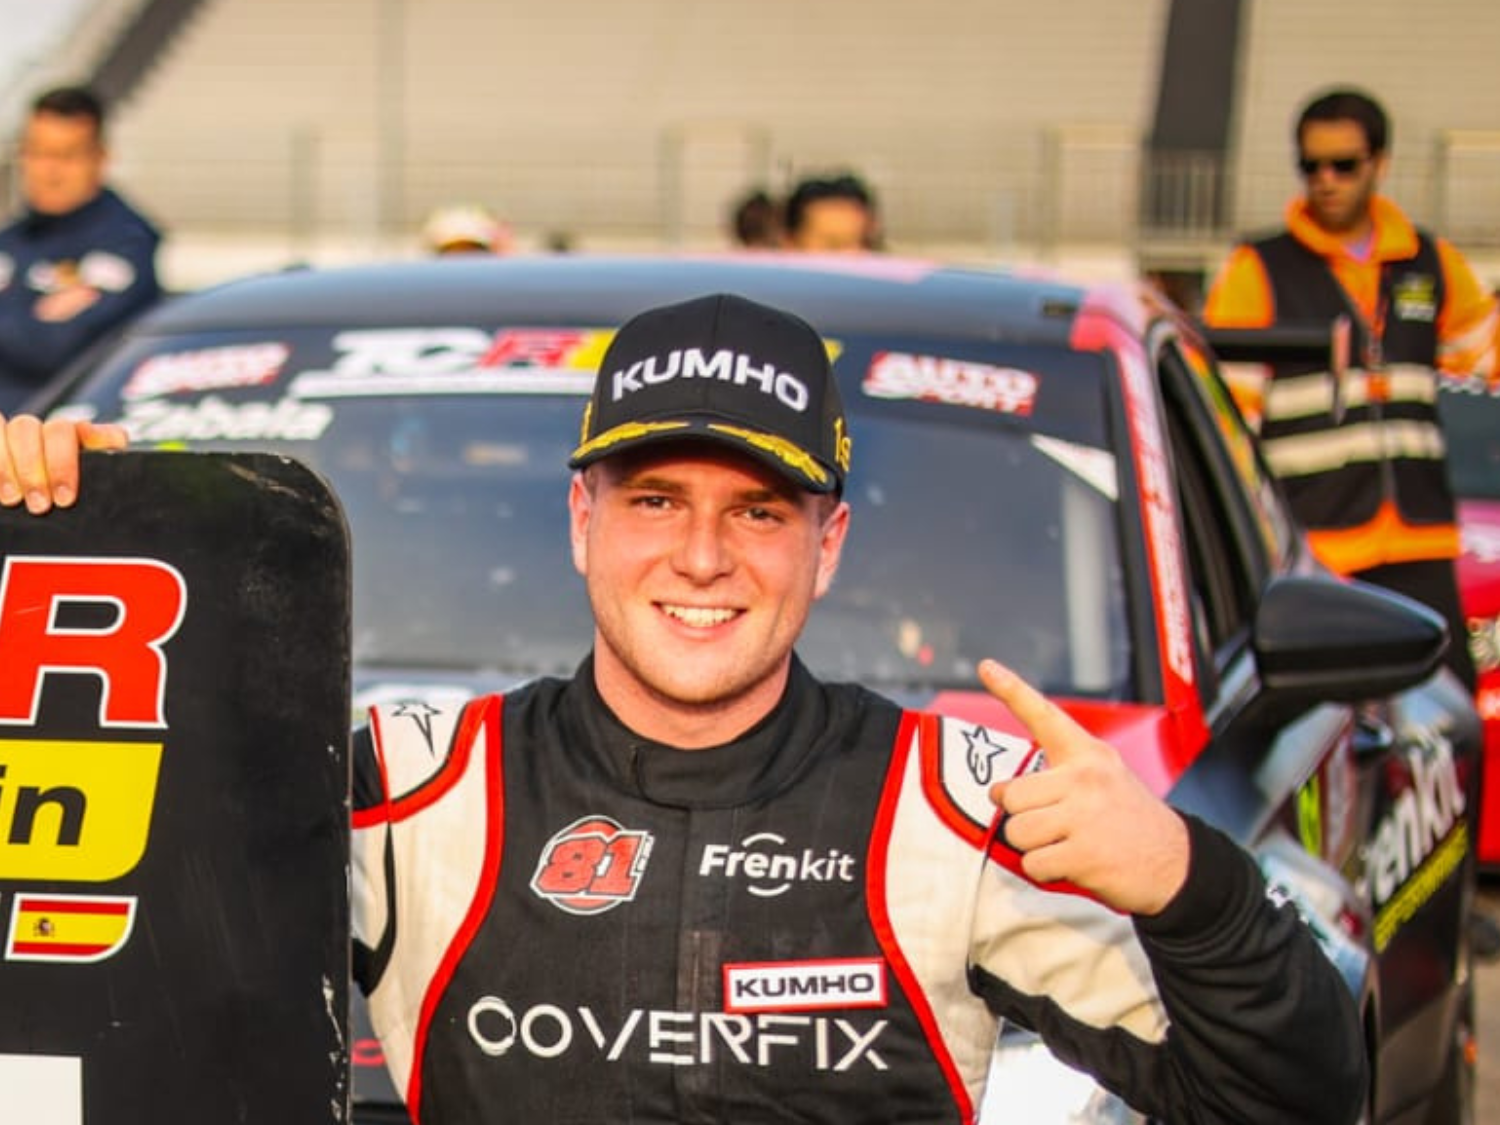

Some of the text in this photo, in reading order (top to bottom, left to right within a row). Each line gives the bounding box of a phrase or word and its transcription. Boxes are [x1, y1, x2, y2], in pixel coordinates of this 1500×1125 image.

[331, 327, 586, 372] TCR
[612, 348, 808, 412] KUMHO
[533, 831, 646, 900] 81
[699, 844, 856, 882] Frenkit
[735, 972, 875, 998] KUMHO
[467, 996, 889, 1072] COVERFIX
